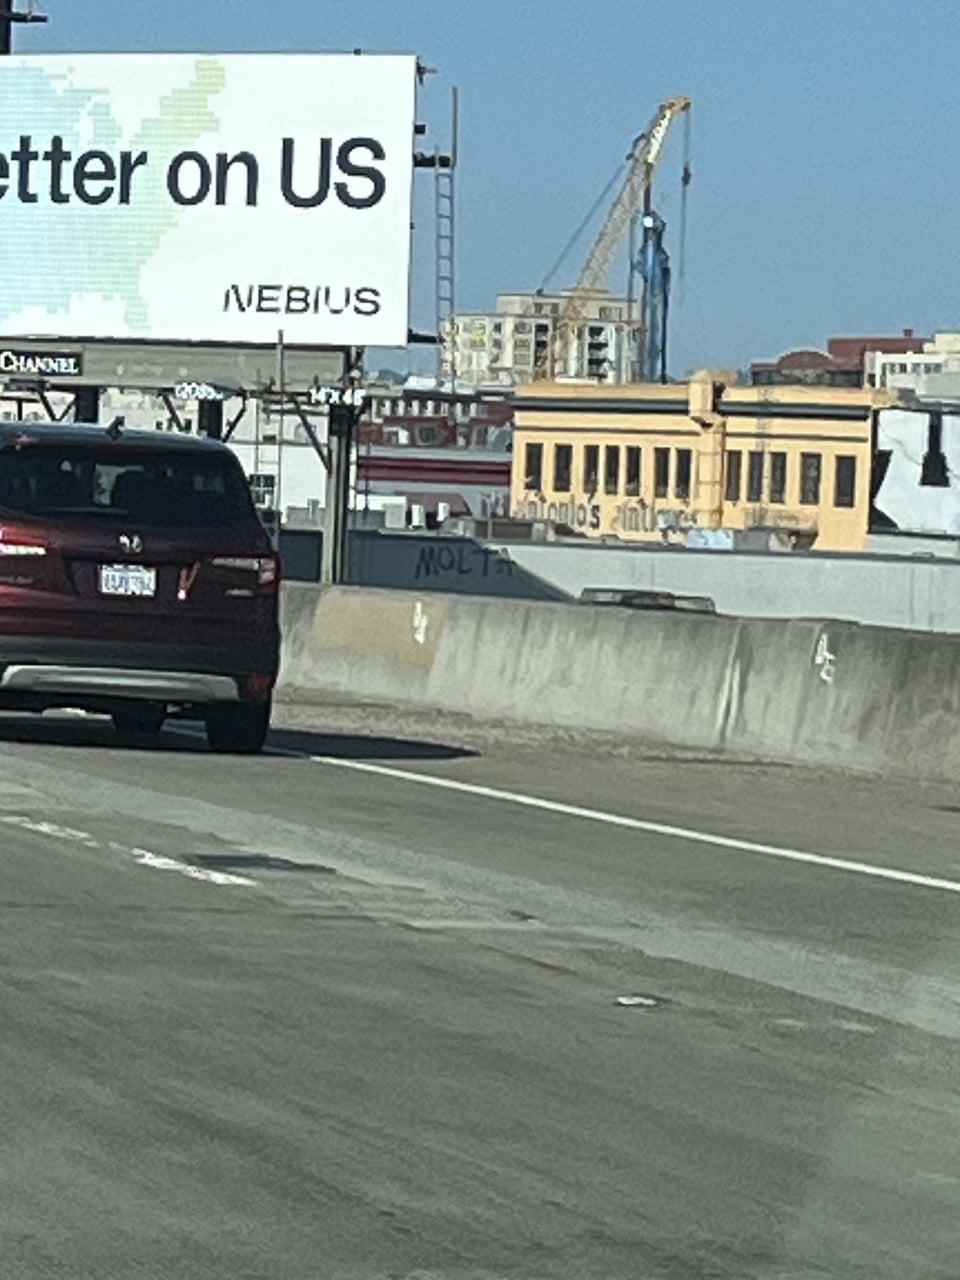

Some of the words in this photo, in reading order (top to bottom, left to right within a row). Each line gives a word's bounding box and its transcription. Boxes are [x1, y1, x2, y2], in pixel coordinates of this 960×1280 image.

[167, 151, 259, 206] on
[280, 137, 386, 209] US
[223, 284, 381, 316] NEBIUS
[0, 351, 79, 373] CHANNEL
